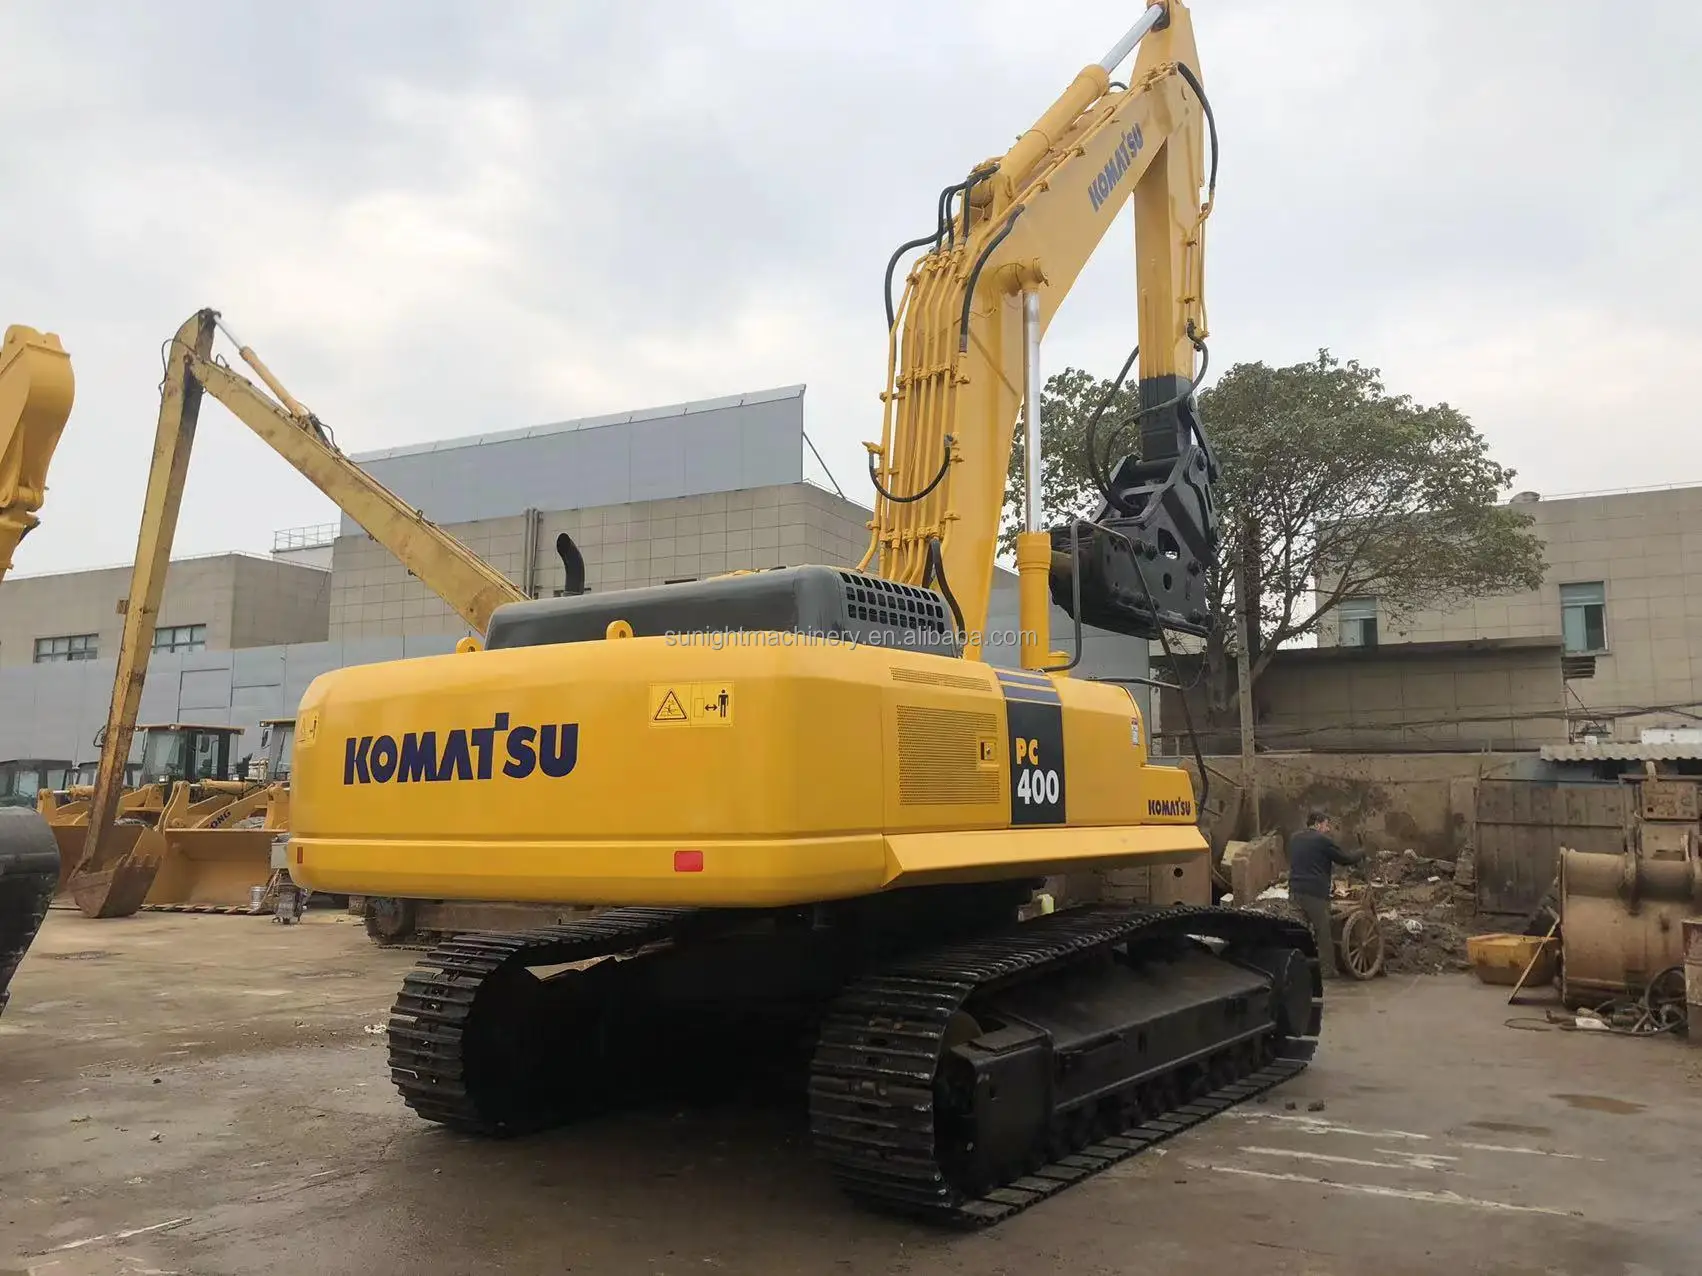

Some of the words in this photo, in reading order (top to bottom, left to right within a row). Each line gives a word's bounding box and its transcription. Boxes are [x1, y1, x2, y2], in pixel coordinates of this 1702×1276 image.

[1088, 123, 1143, 213] KOMATSU
[344, 712, 579, 785] KOMATSU
[1015, 737, 1039, 765] PC
[1017, 768, 1060, 805] 400
[206, 809, 231, 829] ONG
[1148, 797, 1191, 816] KOMATSU
